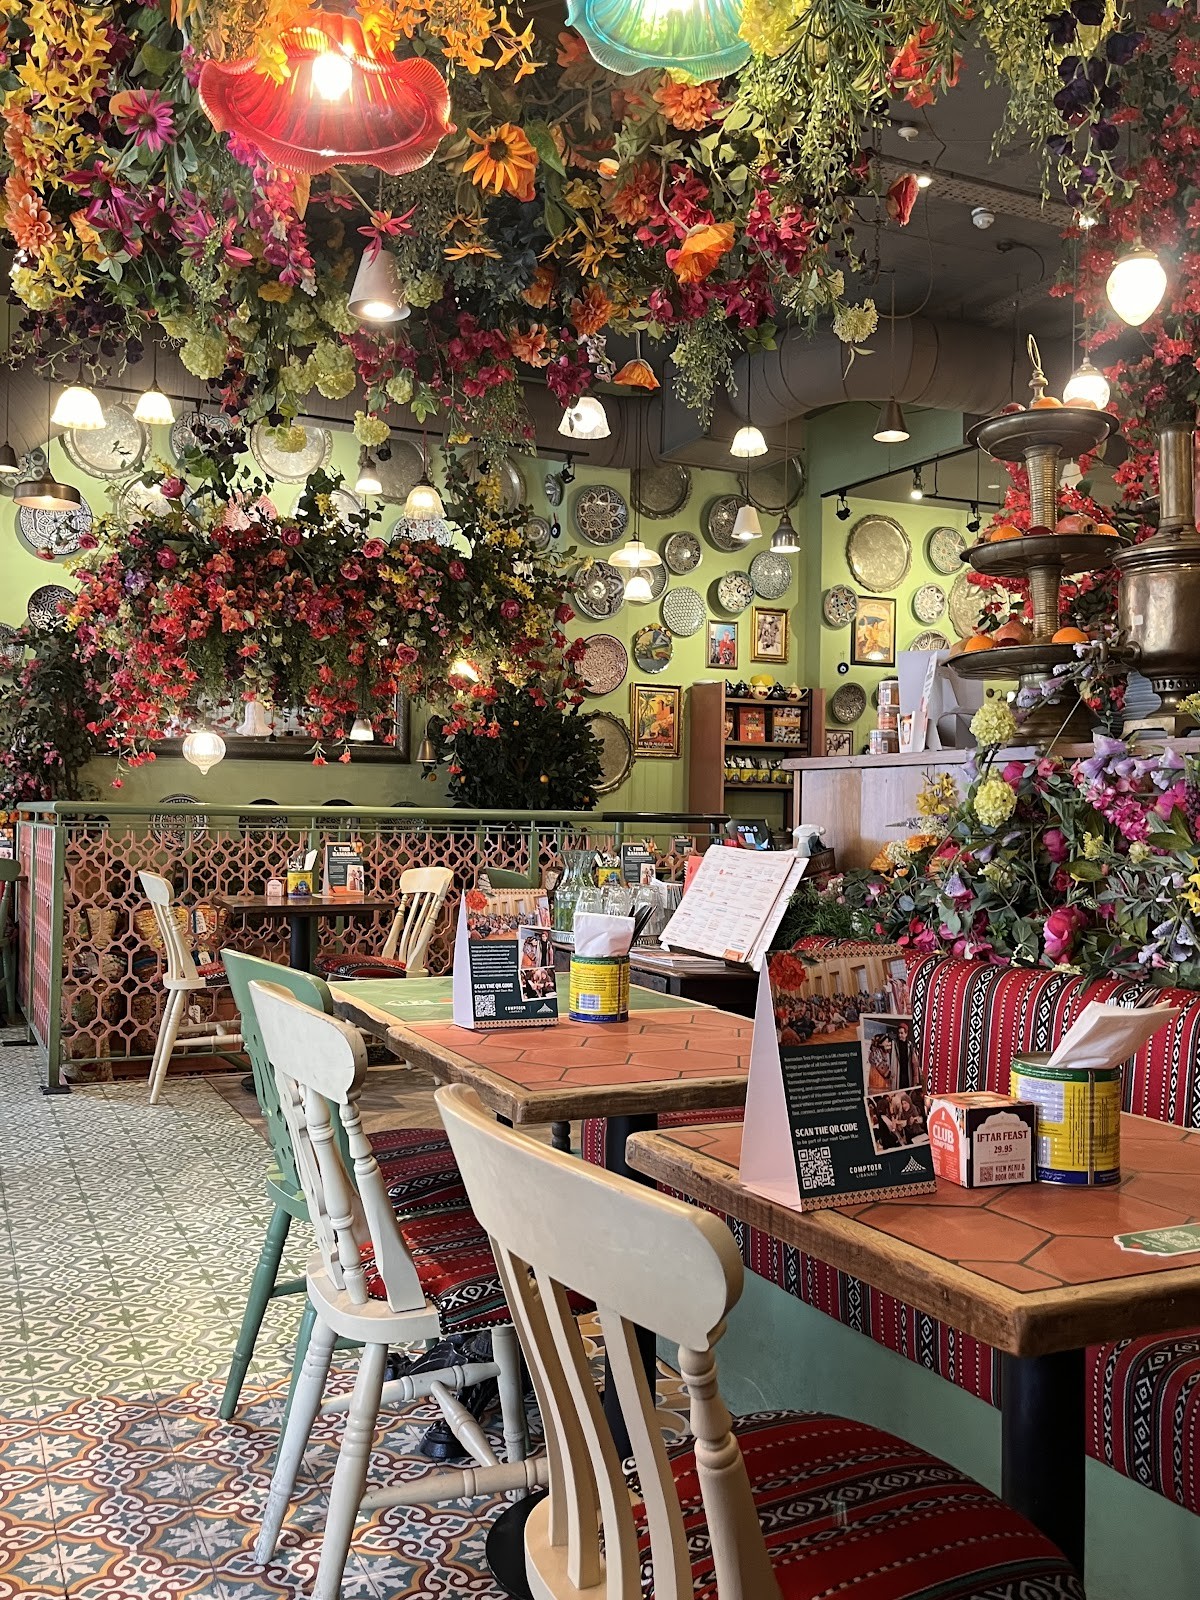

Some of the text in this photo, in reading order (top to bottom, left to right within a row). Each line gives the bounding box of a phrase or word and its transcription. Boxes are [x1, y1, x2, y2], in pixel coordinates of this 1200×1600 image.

[795, 1122, 858, 1137] SCAN THE QR CODE
[932, 1124, 954, 1144] CLUB
[977, 1130, 1028, 1142] IFTAR FEAST
[994, 1144, 1012, 1153] 29.95
[849, 1163, 882, 1174] COMPTOIR
[995, 1164, 1006, 1172] VIEW
[1008, 1164, 1020, 1172] MENU
[1008, 1172, 1024, 1180] ONLINE
